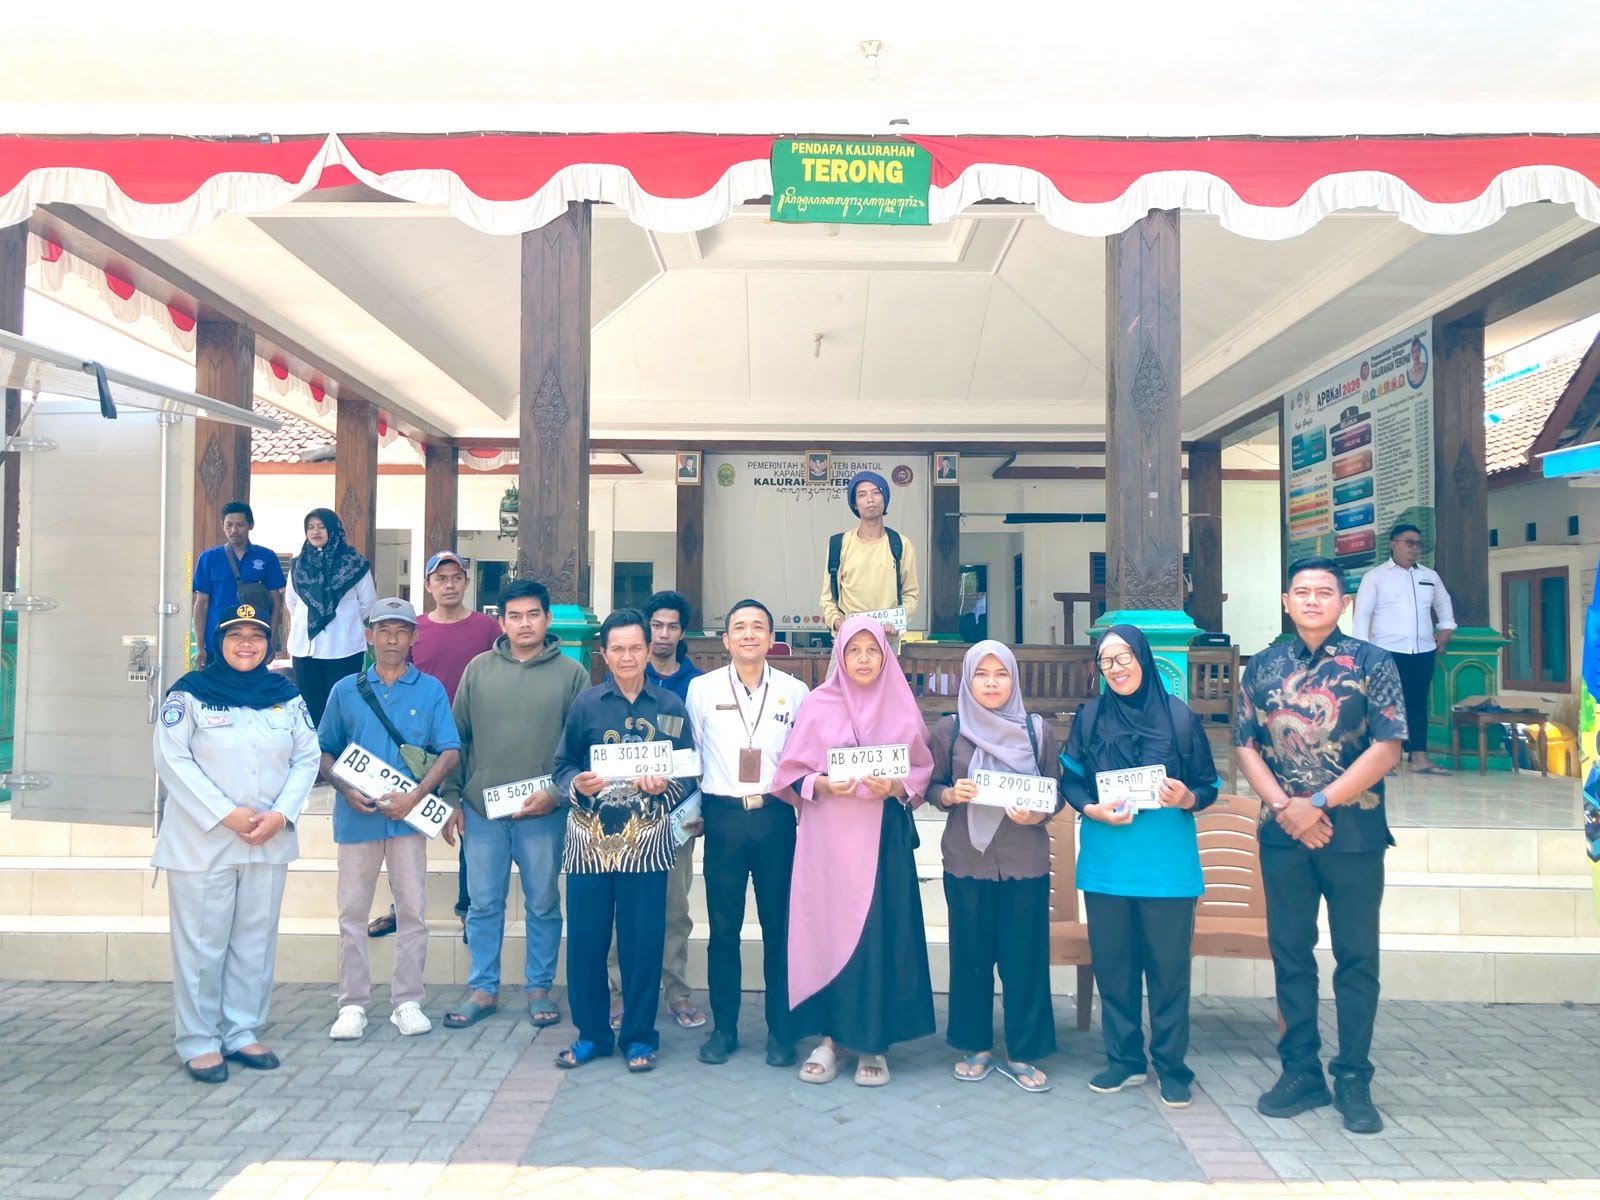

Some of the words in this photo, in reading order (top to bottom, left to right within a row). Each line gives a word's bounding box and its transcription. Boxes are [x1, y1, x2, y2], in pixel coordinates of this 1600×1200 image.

[791, 143, 843, 155] PENDAPA
[846, 144, 915, 157] KALURAHAN
[802, 158, 903, 183] TERONG
[747, 462, 798, 470] PEMERINTAH
[851, 462, 883, 470] BANTUL
[774, 470, 805, 478] KAPANE
[832, 470, 857, 478] LINGO
[830, 478, 850, 486] TER
[593, 749, 607, 761] AB
[619, 745, 648, 760] 3012
[654, 745, 668, 758] UK
[831, 752, 845, 765] AB
[852, 750, 883, 764] 6703
[892, 748, 906, 761] XT
[343, 748, 370, 773] AB
[420, 798, 447, 824] BB
[976, 773, 990, 787] AB
[999, 776, 1031, 791] 2990
[1038, 780, 1053, 795] UK
[487, 790, 501, 803] AB
